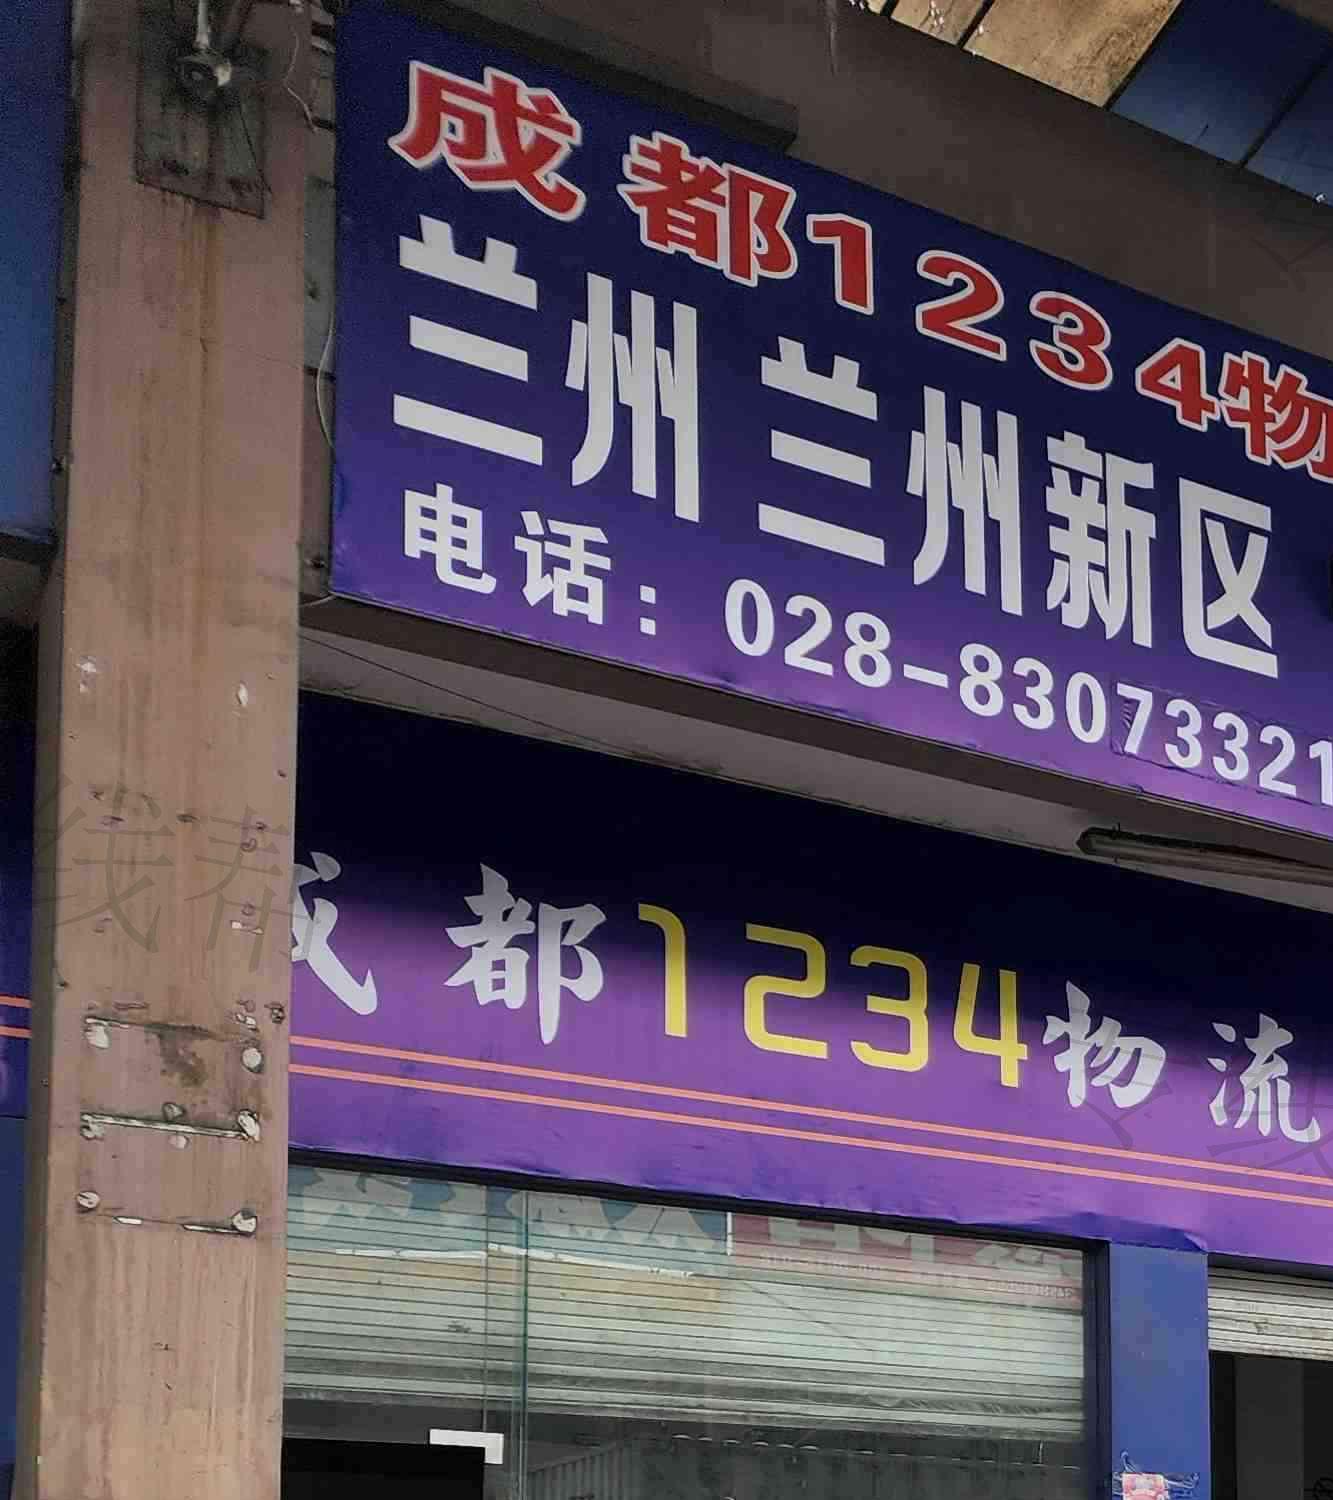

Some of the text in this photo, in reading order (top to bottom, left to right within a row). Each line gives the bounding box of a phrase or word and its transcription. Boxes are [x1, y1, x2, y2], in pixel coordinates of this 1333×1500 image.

[392, 214, 702, 525] 兰州
[757, 335, 1280, 679] 兰州新区
